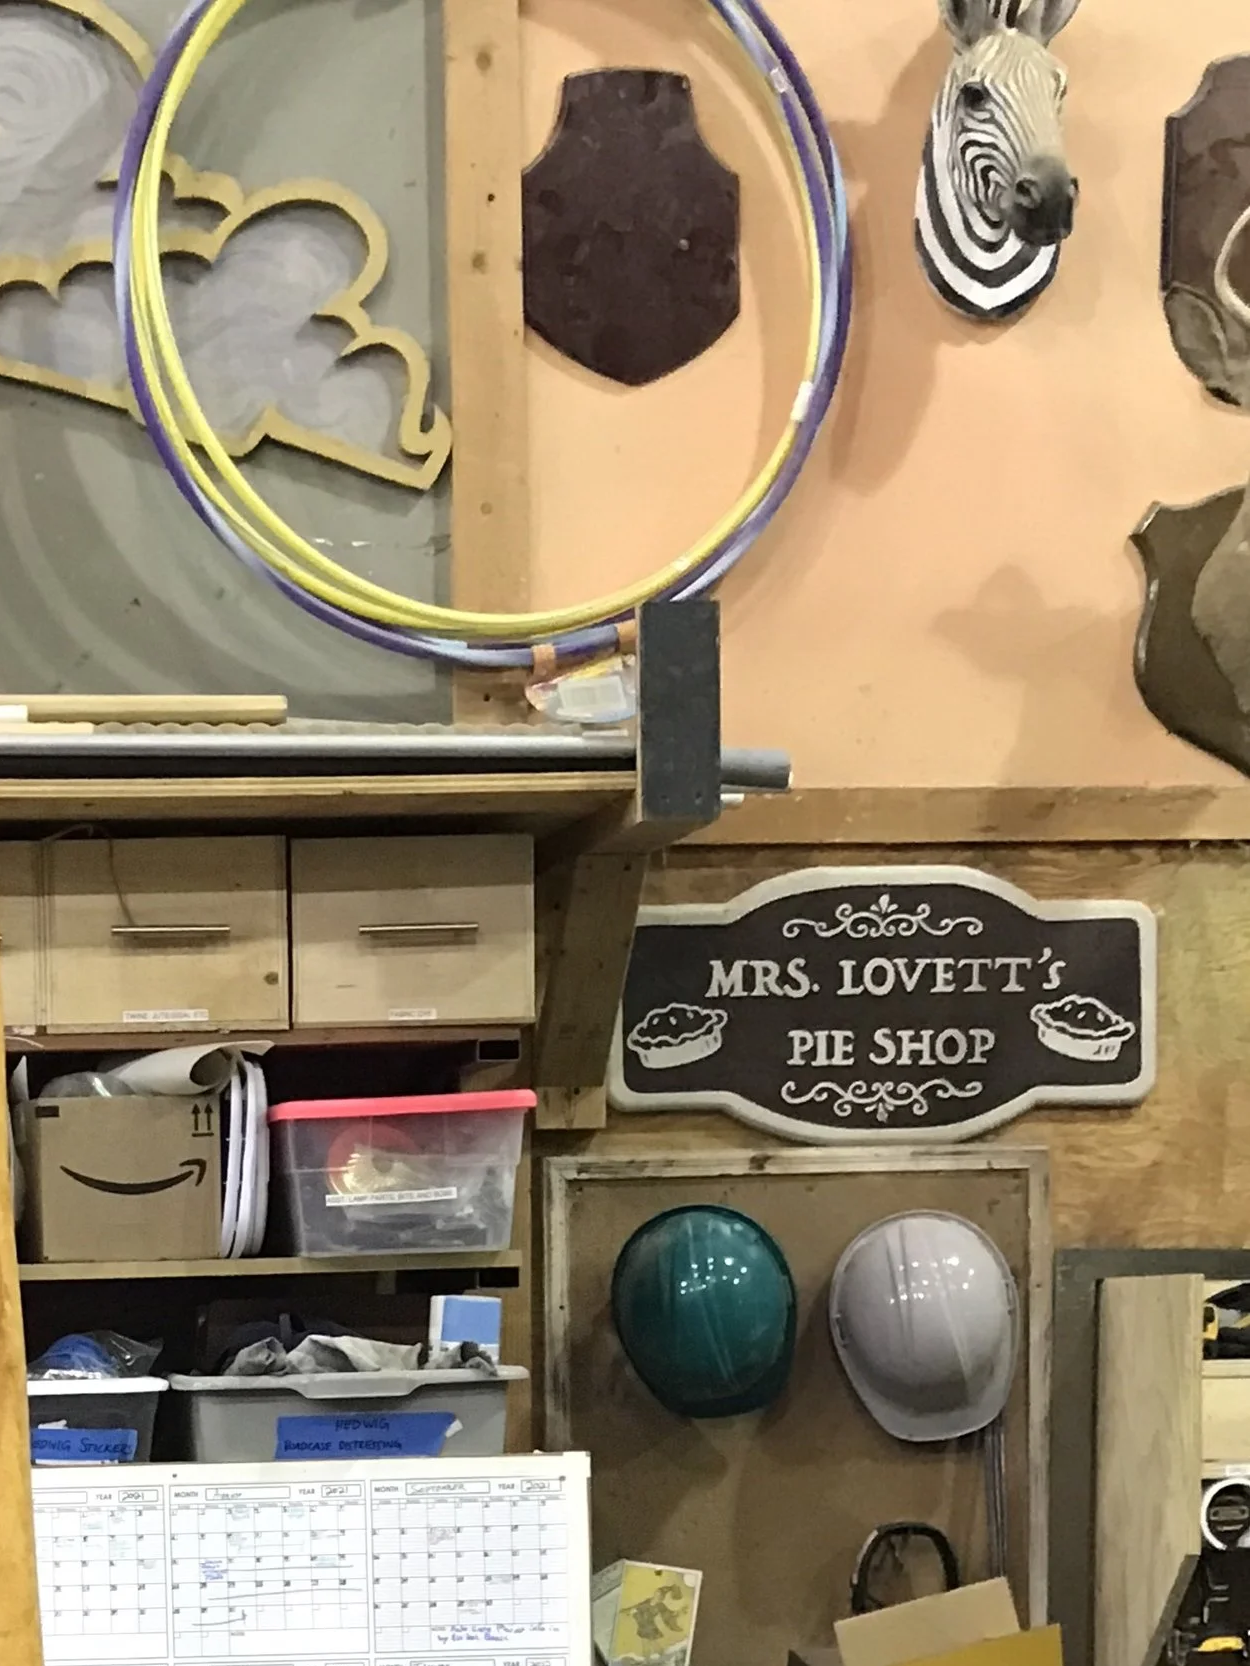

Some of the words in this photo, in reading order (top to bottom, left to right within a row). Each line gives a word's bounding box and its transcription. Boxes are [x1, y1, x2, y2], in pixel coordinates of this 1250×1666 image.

[705, 958, 820, 998] MRS.
[787, 1030, 855, 1067] PIE
[869, 1028, 996, 1067] SHOP
[334, 1418, 390, 1432] HEDWIG
[32, 1439, 71, 1452] EDWIG
[324, 1486, 349, 1497] 2021
[525, 1480, 551, 1491] 2021
